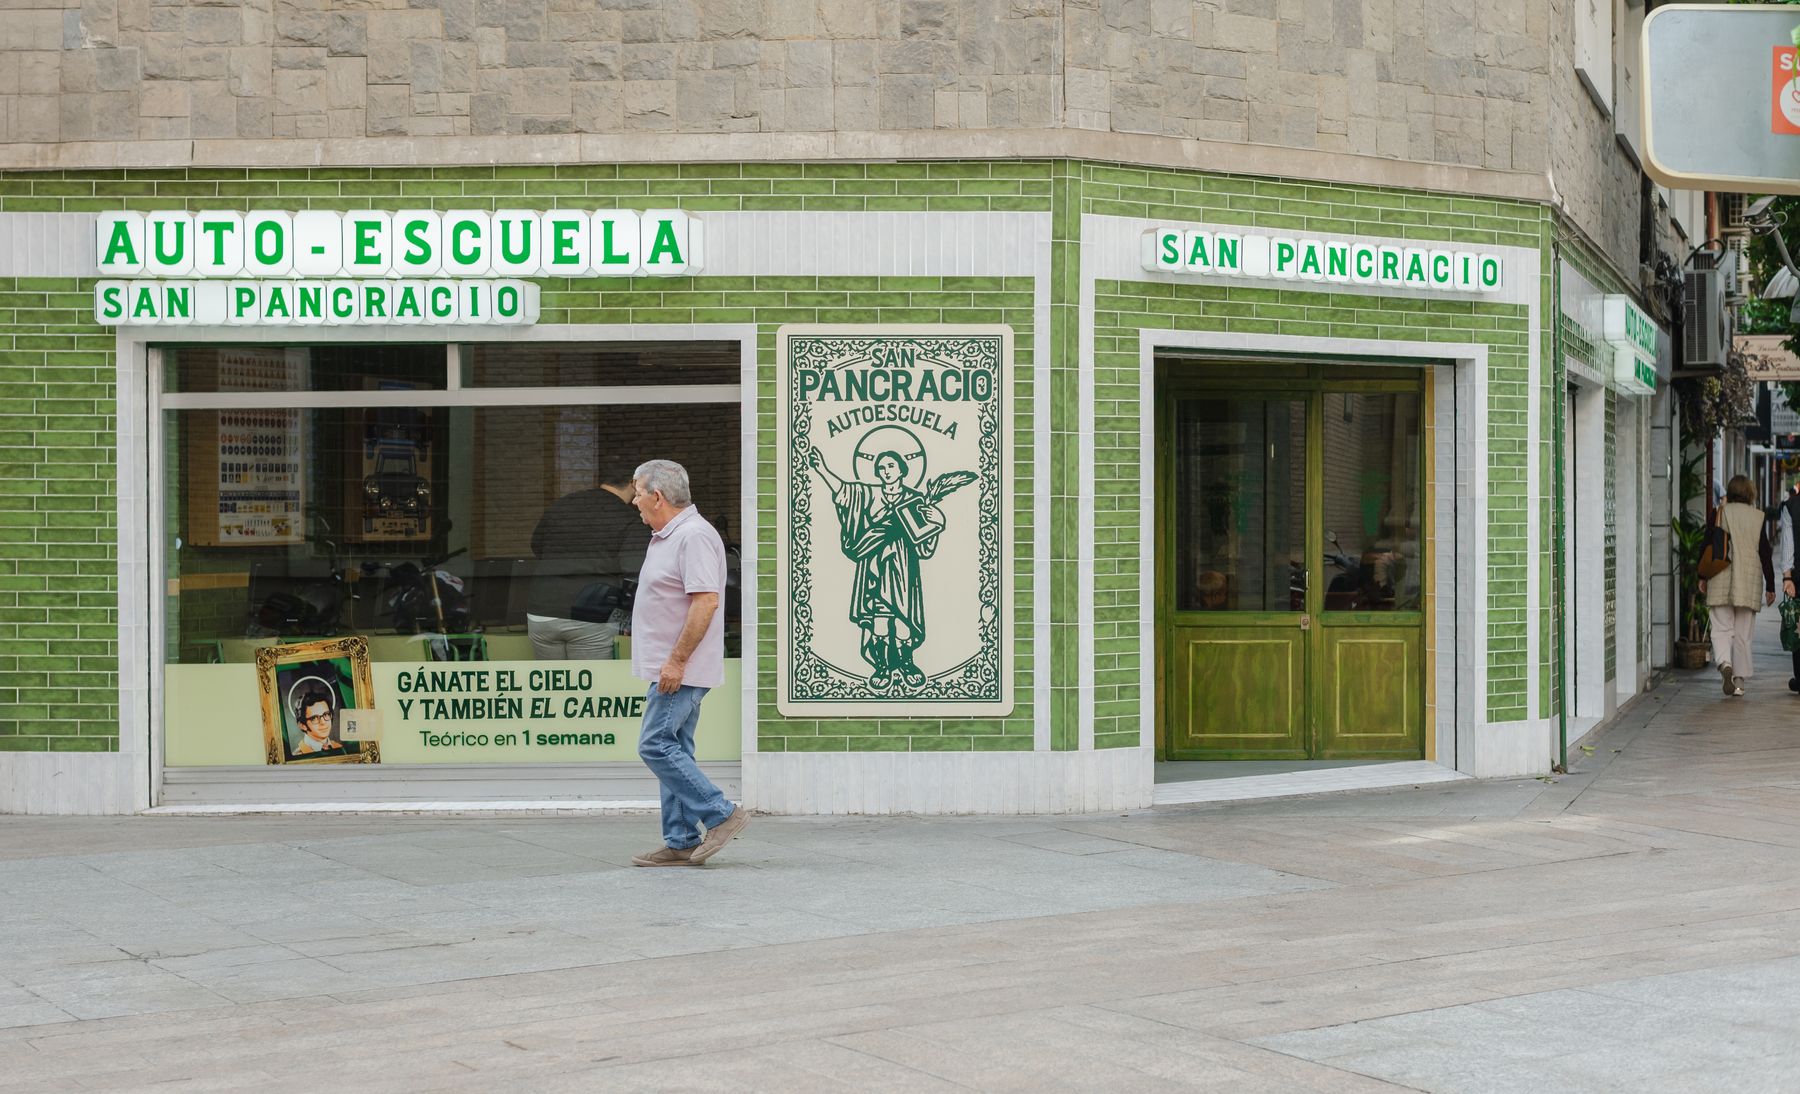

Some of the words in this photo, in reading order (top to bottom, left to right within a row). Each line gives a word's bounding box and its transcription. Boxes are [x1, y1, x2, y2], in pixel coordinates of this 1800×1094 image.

[102, 220, 685, 266] AUTO-ESCUELA
[1162, 234, 1238, 269] SAN
[1276, 243, 1498, 287] PANCRACIO
[103, 287, 189, 318] SAN
[235, 287, 518, 318] PANCRACIO
[871, 348, 915, 368] SAN
[799, 369, 992, 401] PANCRACIO
[827, 404, 958, 440] AUTOESCUELA
[398, 666, 490, 693] GÁNATE
[496, 671, 522, 691] EL
[529, 669, 593, 691] CIELO
[398, 699, 414, 720] Y
[420, 693, 524, 719] TAMBIÉN
[530, 697, 556, 719] EL
[563, 696, 646, 718] CARNE
[420, 730, 489, 747] Teórico
[494, 734, 517, 746] en
[522, 730, 530, 745] 1
[536, 732, 616, 746] semana
